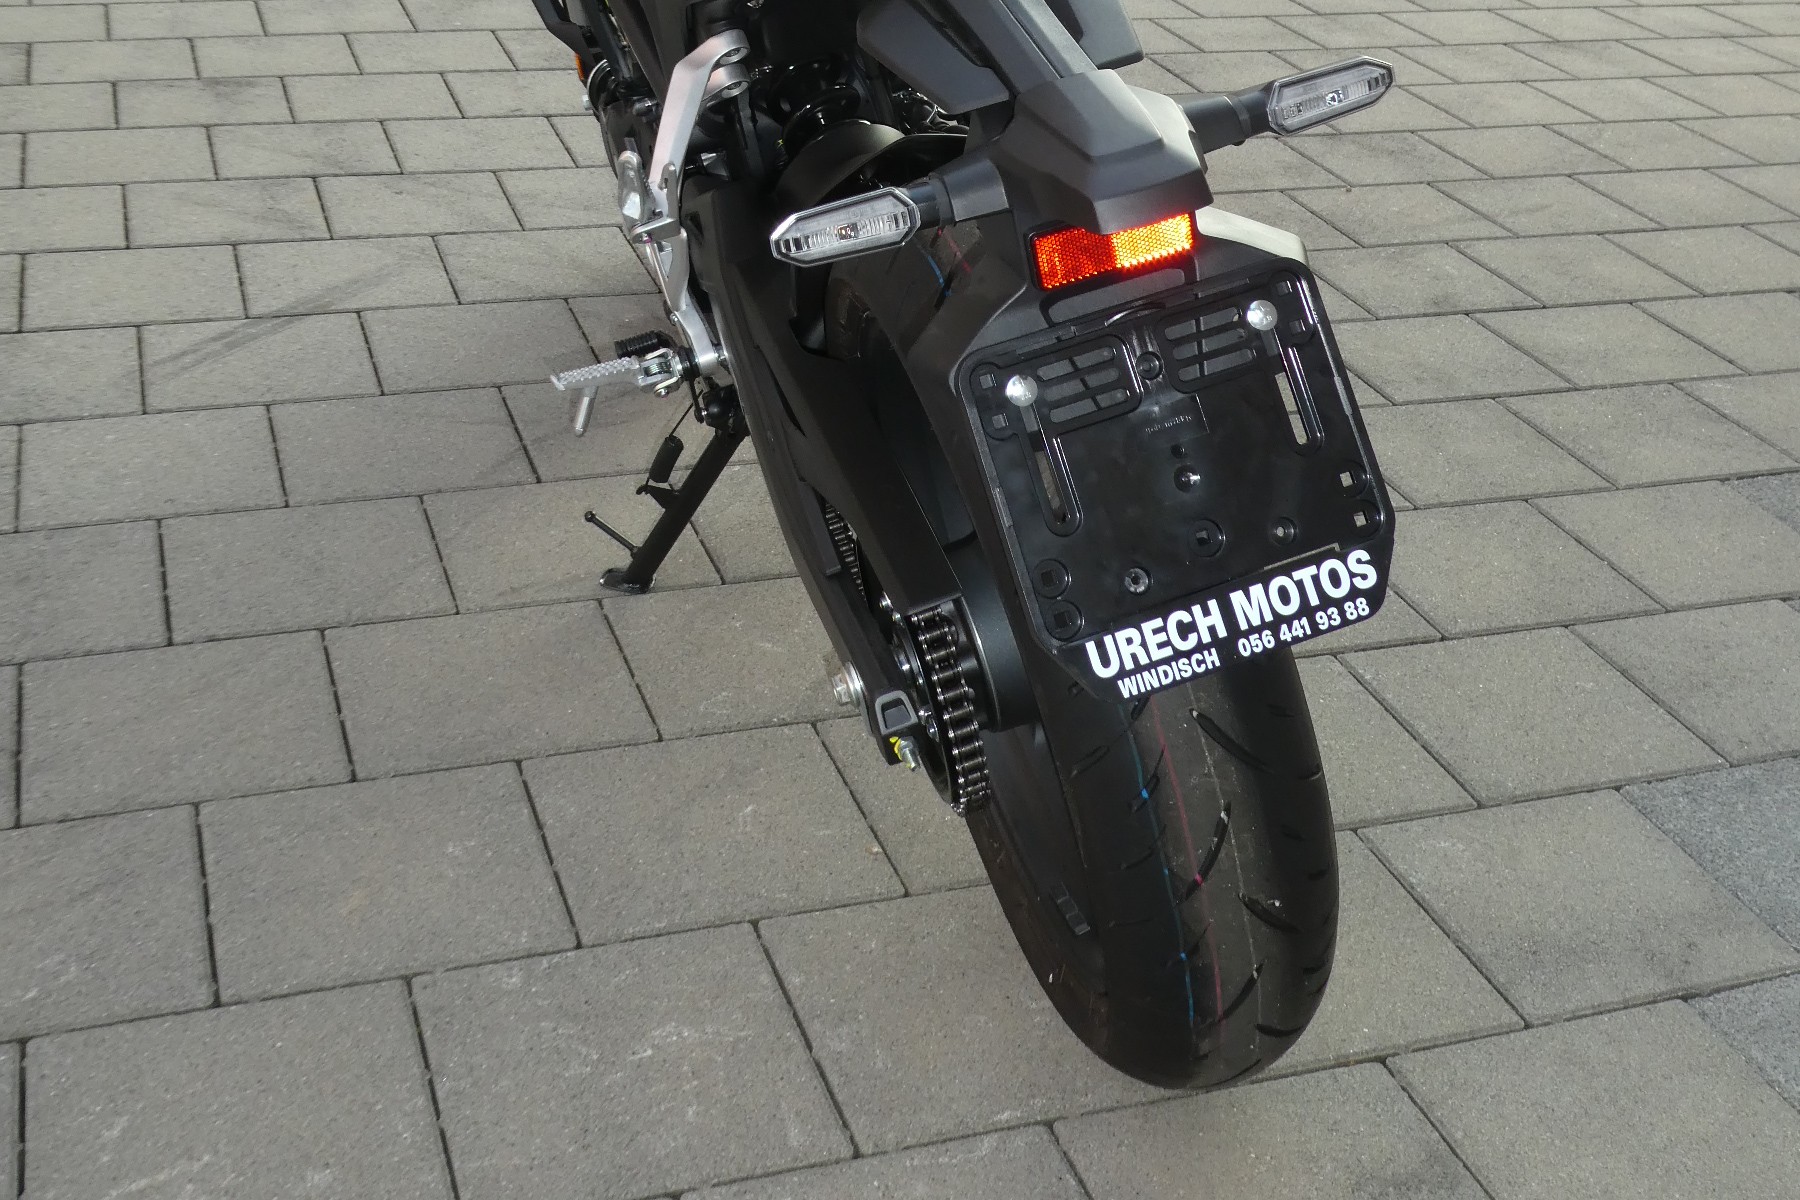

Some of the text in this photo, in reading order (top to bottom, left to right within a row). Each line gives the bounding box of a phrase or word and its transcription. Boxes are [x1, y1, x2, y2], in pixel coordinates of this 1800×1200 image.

[1085, 550, 1378, 679] URECH MOTOS
[1117, 597, 1370, 699] WINDISCH 056 441 93 88
